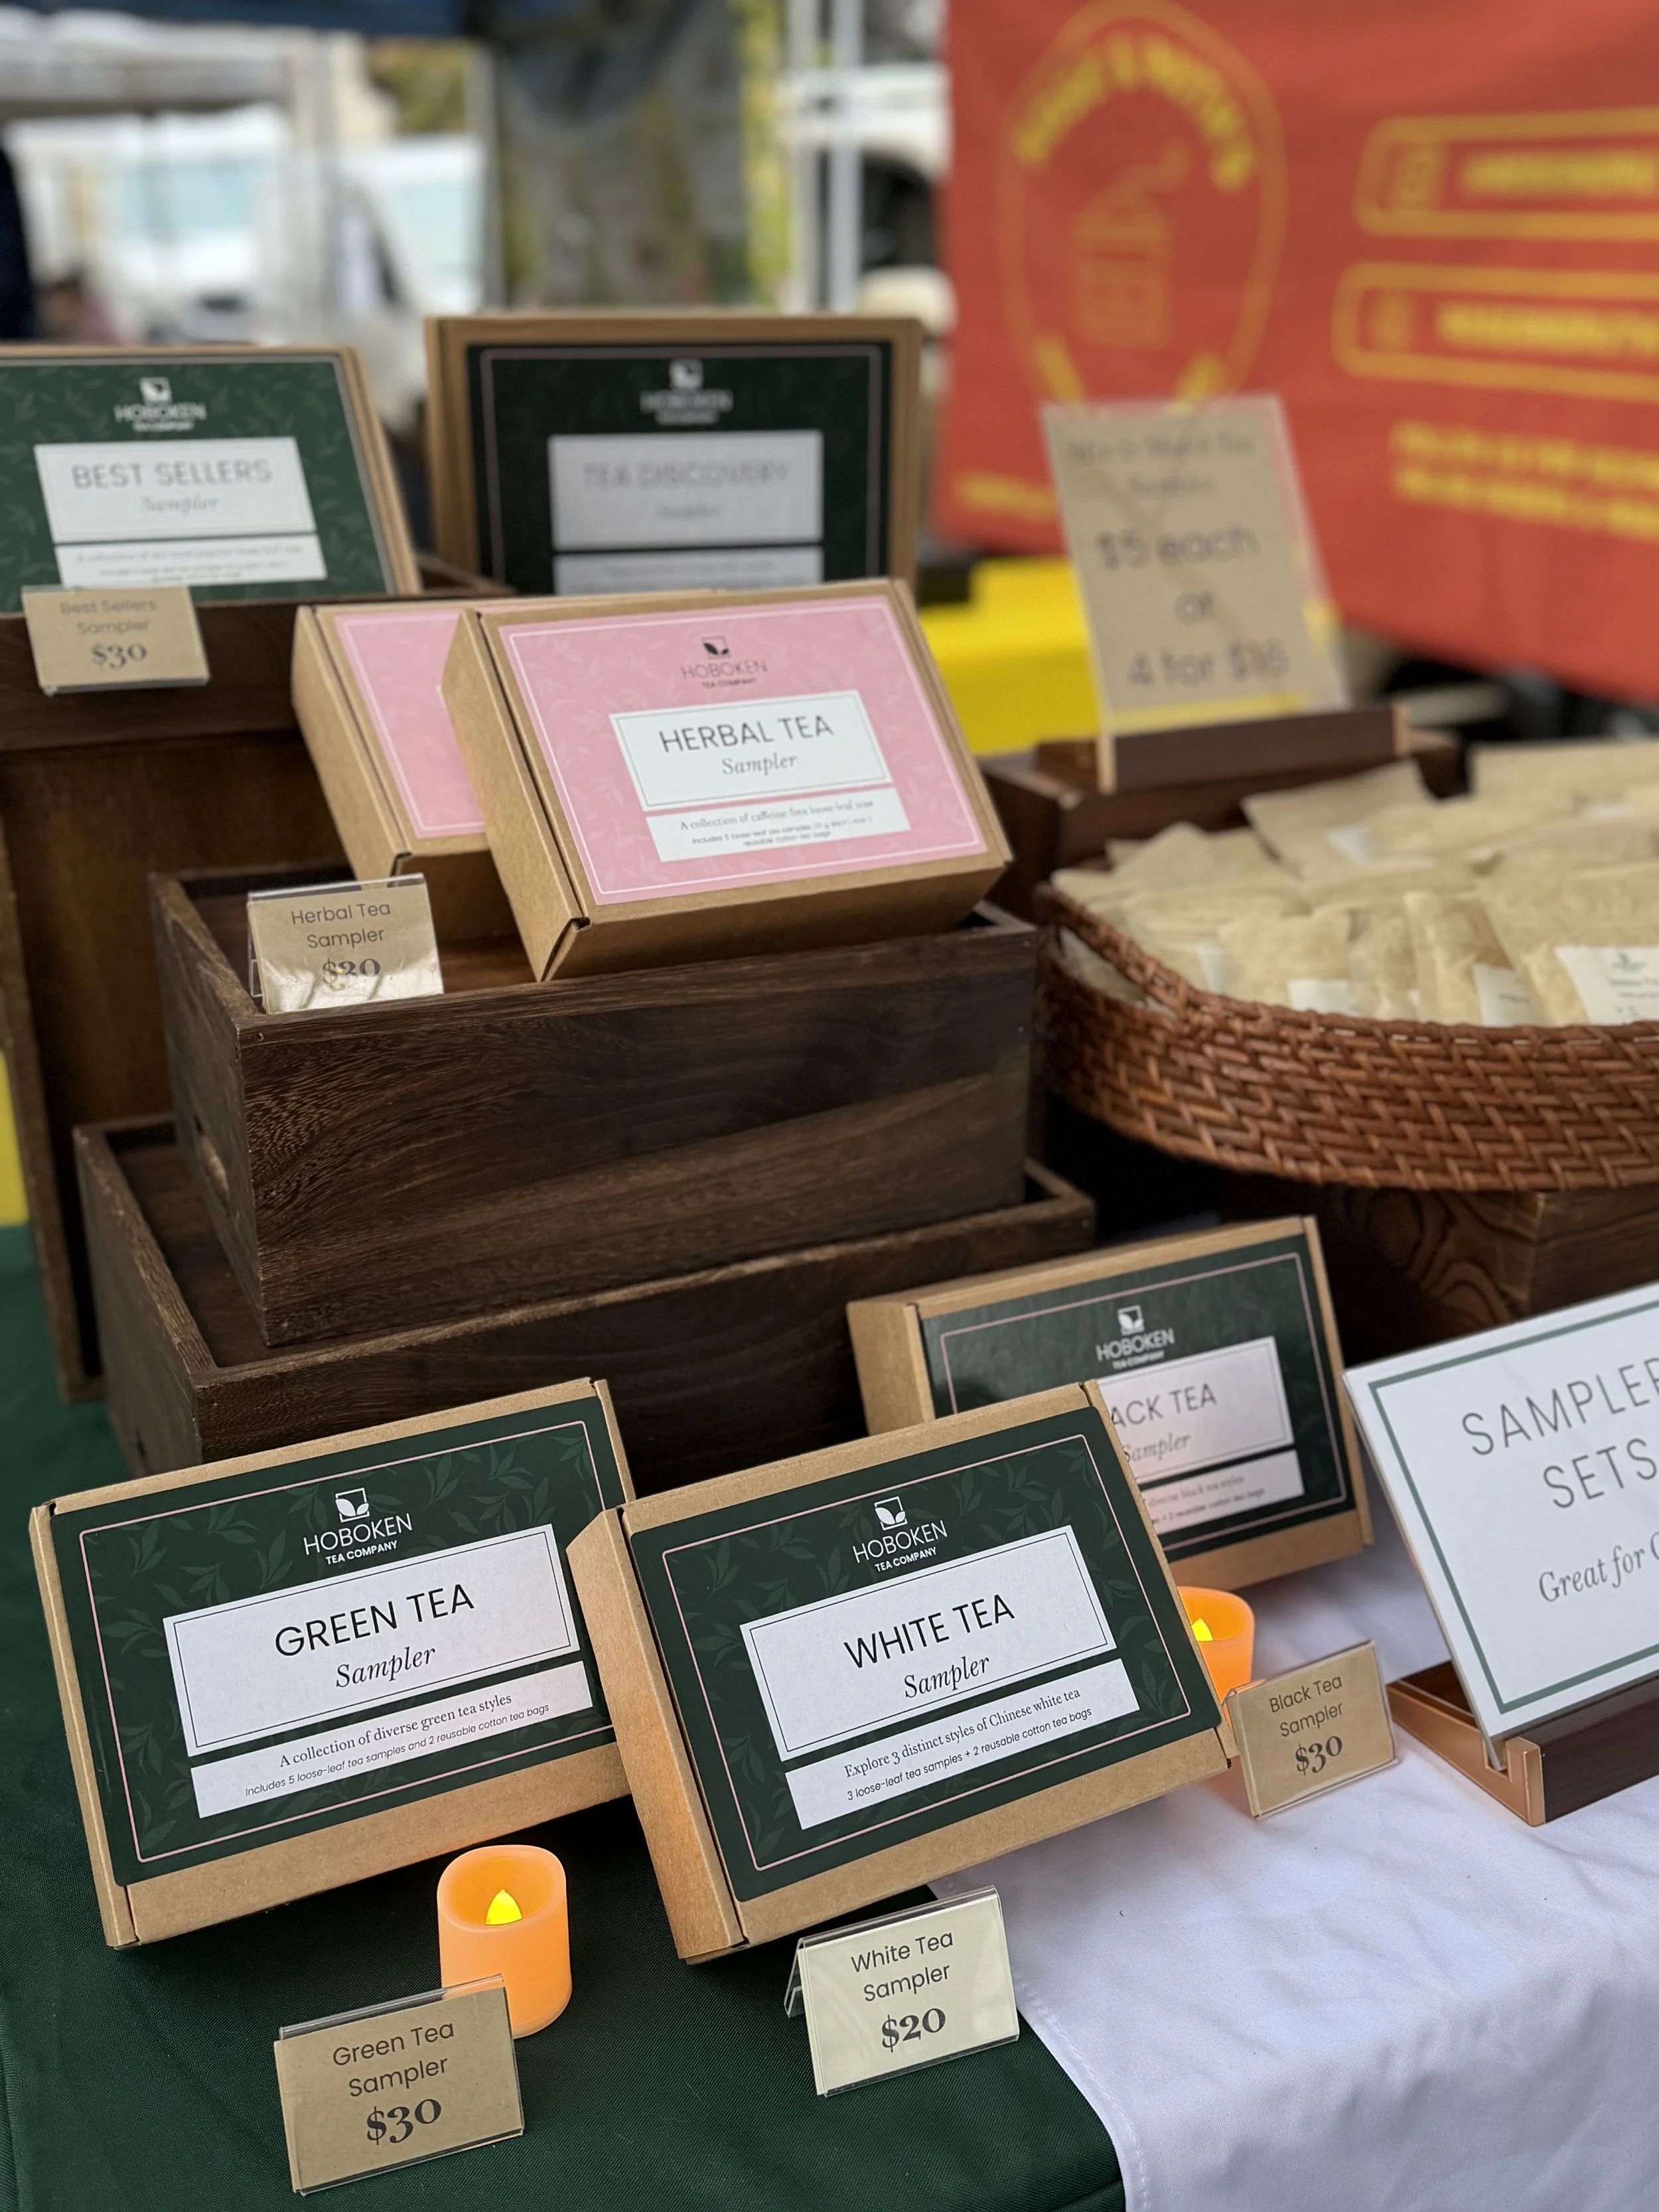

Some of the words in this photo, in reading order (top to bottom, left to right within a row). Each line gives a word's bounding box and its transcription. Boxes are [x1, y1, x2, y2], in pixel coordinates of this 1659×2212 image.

[72, 464, 143, 490] BEST
[155, 459, 273, 486] SELLERS
[1155, 522, 1259, 567] each
[60, 600, 98, 615] Best
[101, 599, 158, 613] Sellers
[1173, 591, 1215, 627] or
[76, 619, 149, 636] Sampler
[92, 642, 148, 670] $30
[680, 659, 768, 681] HOBOKEN
[1127, 650, 1155, 686] 4
[1160, 646, 1214, 688] for
[701, 680, 717, 689] TEA
[659, 721, 774, 753] HERBAL
[777, 715, 835, 741] TEA
[721, 753, 798, 776] Sampler
[680, 820, 689, 831] A
[690, 817, 738, 830] collection
[739, 812, 749, 824] of
[751, 810, 787, 822] caffeine
[291, 904, 352, 924] Herbal
[356, 903, 391, 919] Tea
[307, 928, 384, 948] Sampler
[1096, 1327, 1175, 1361] HOBOKEN
[1111, 1394, 1165, 1428] ACK
[1169, 1382, 1218, 1414] TEA
[1122, 1432, 1192, 1463] Sampler
[1543, 1438, 1658, 1509] SETS
[303, 1512, 413, 1556] HOBOKEN
[325, 1553, 346, 1565] TEA
[346, 1540, 397, 1560] COMPANY
[853, 1520, 948, 1563] HOBOKEN
[875, 1560, 893, 1572] TEA
[893, 1546, 936, 1566] COMPANY
[1539, 1558, 1608, 1603] Great
[1612, 1545, 1646, 1588] for
[275, 1599, 398, 1657] GREEN
[406, 1583, 474, 1623] TEA
[843, 1612, 950, 1669] WHITE
[952, 1593, 1015, 1633] TEA
[335, 1645, 437, 1688] Sampler
[903, 1654, 991, 1699] Sampler
[1269, 1686, 1312, 1713] Black
[1313, 1675, 1342, 1696] Tea
[279, 1754, 291, 1769] A
[293, 1739, 356, 1765] collection
[358, 1730, 372, 1745] of
[374, 1720, 419, 1741] diverse
[421, 1710, 456, 1732] green
[458, 1706, 478, 1718] tea
[479, 1694, 512, 1713] styles
[843, 1755, 891, 1778] Explore
[892, 1751, 901, 1765] 3
[902, 1735, 944, 1758] distinct
[946, 1726, 975, 1743] styles
[977, 1717, 988, 1732] of
[989, 1706, 1033, 1727] Chinese
[1033, 1695, 1063, 1712] white
[1064, 1689, 1082, 1702] tea
[1279, 1702, 1343, 1737] Sampler
[246, 1779, 286, 1797] Includes
[289, 1775, 295, 1785] 5
[297, 1761, 346, 1783] loose-leaf
[348, 1757, 364, 1768] tea
[366, 1745, 406, 1763] samples
[408, 1737, 427, 1751] and
[429, 1735, 435, 1745] 2
[437, 1724, 476, 1743] reusable
[478, 1715, 508, 1731] cotton
[510, 1711, 525, 1722] tea
[527, 1703, 549, 1717] bags
[847, 1790, 854, 1801] 3
[855, 1771, 904, 1799] loose-leaf
[905, 1768, 922, 1781] tea
[923, 1752, 963, 1773] samples
[973, 1745, 980, 1756] 2
[981, 1733, 1021, 1754] reusable
[1022, 1722, 1052, 1738] cotton
[1052, 1716, 1068, 1728] tea
[1069, 1707, 1092, 1722] bags
[1295, 1735, 1343, 1776] $30
[851, 1944, 911, 1973] White
[915, 1931, 954, 1955] Tea
[863, 1964, 950, 2002] Sampler
[332, 2035, 405, 2067] Green
[410, 2022, 455, 2047] Tea
[881, 2008, 946, 2053] $20
[348, 2057, 448, 2097] Sampler
[366, 2098, 441, 2146] $30
